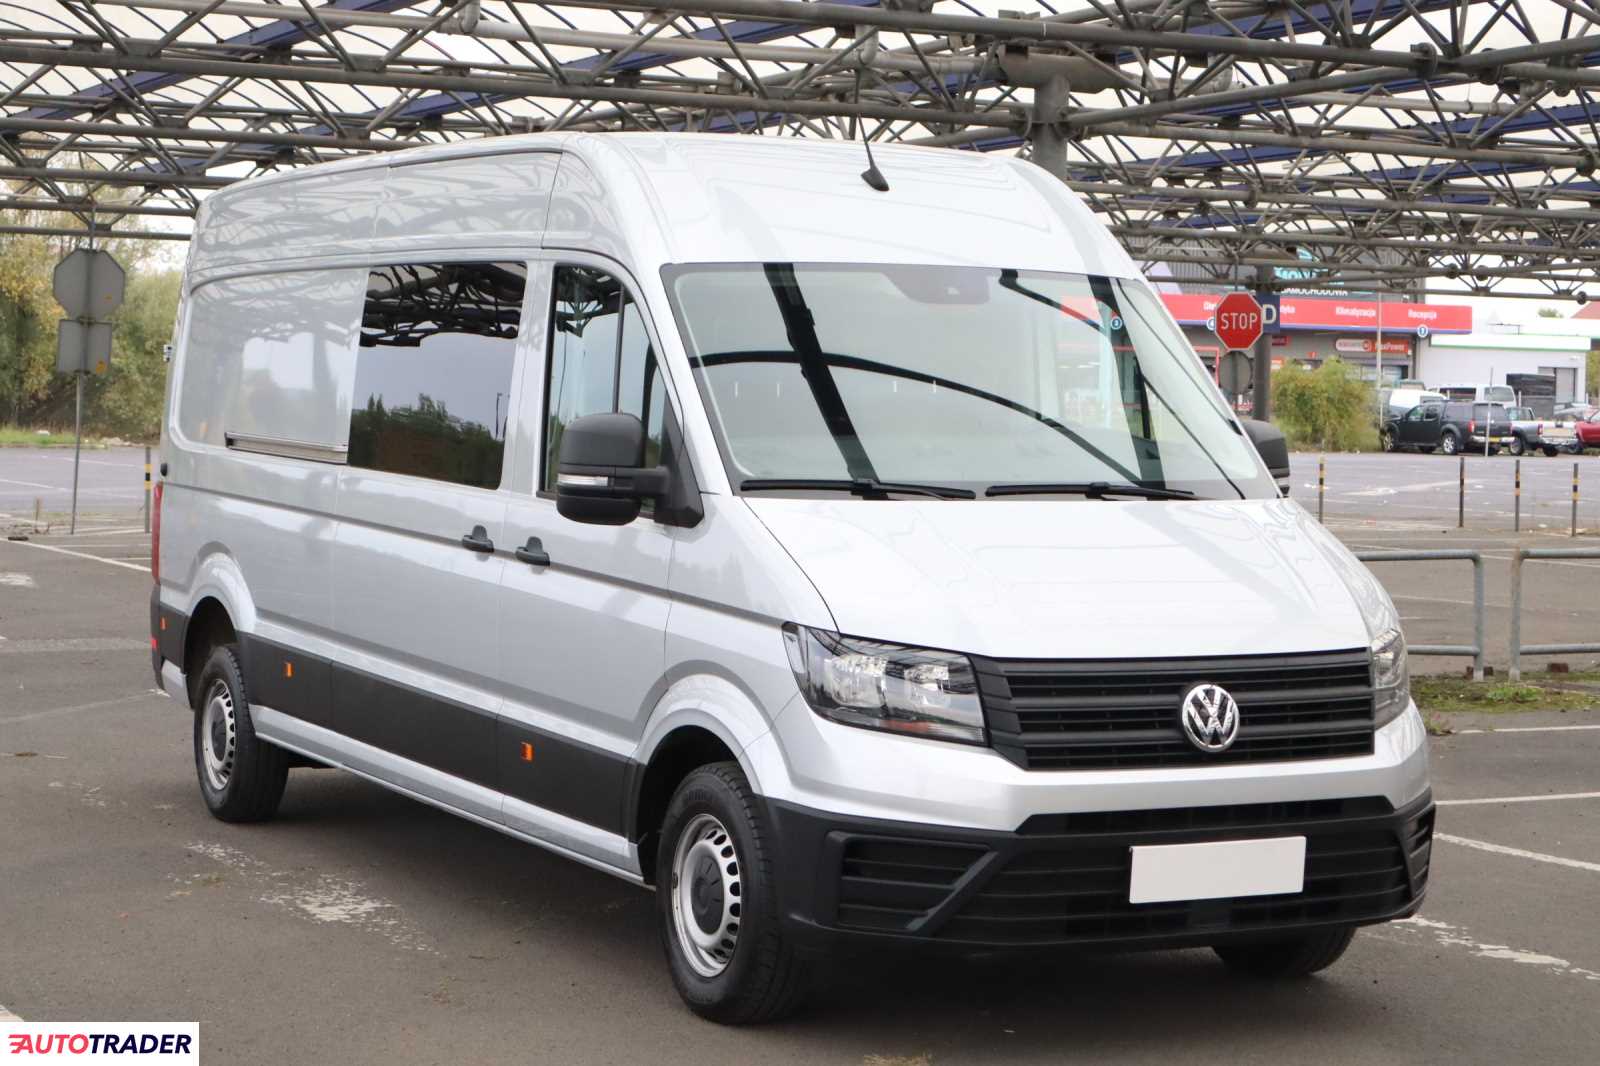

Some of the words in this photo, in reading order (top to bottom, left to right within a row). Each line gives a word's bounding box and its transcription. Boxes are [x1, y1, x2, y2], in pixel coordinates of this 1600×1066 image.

[1221, 312, 1258, 330] STOP
[1262, 304, 1277, 324] D
[1182, 684, 1240, 752] VW
